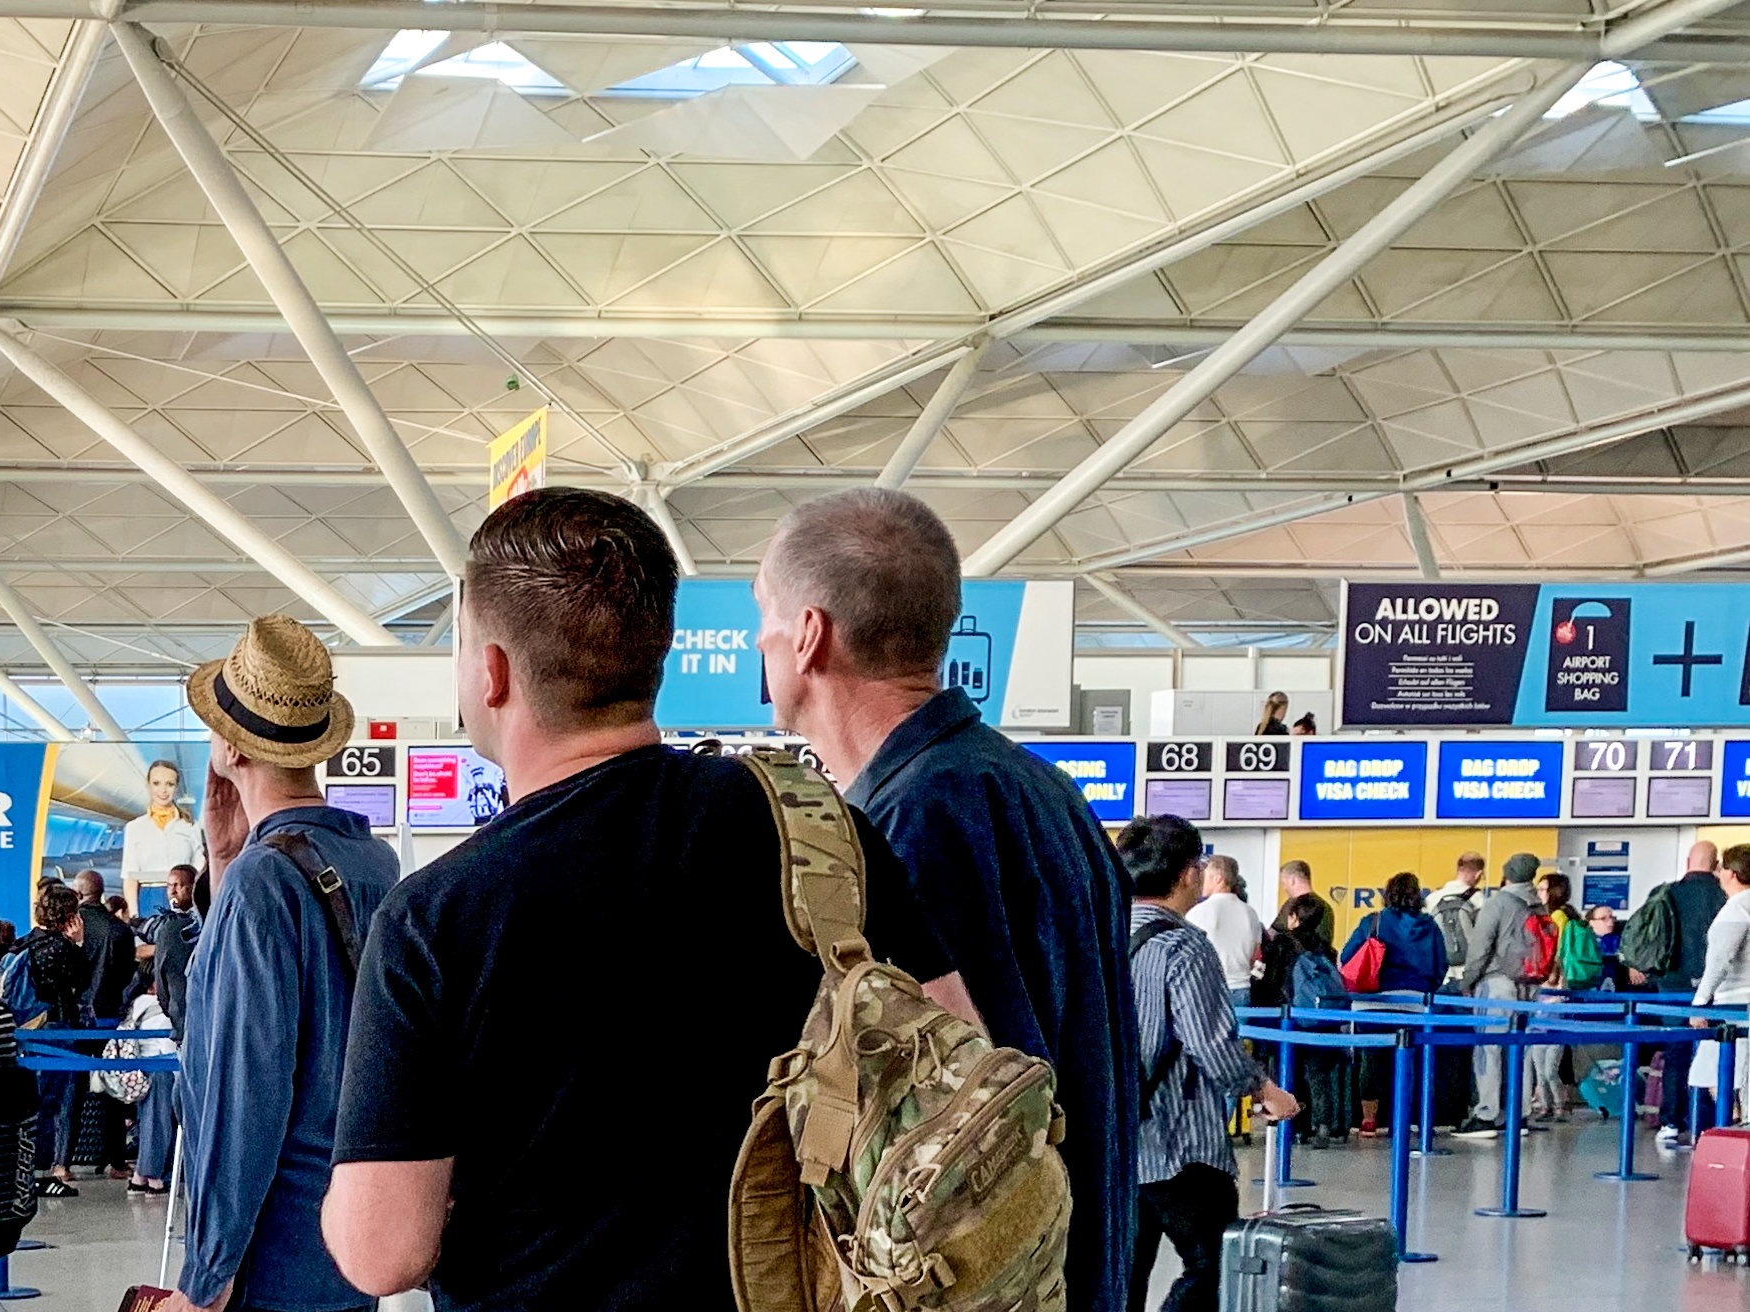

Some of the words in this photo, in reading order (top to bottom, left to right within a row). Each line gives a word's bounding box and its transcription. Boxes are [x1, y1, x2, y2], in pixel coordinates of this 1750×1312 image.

[1375, 598, 1499, 621] ALLOWED
[672, 629, 748, 650] CHECK
[1355, 623, 1392, 643] ON
[1398, 624, 1430, 644] ALL
[1437, 624, 1515, 644] FLIGHTS
[1587, 626, 1593, 650] 1
[681, 654, 702, 674] IT
[709, 654, 736, 674] IN
[1563, 656, 1610, 668] AIRPORT
[1557, 672, 1619, 684] SHOPPING
[1575, 688, 1600, 700] BAG
[341, 748, 382, 776] 65
[1161, 743, 1198, 771] 68
[1239, 743, 1277, 771] 69
[1588, 742, 1625, 771] 70
[1664, 741, 1697, 770] 71
[1324, 760, 1357, 778] BAG
[1359, 759, 1403, 778] DROP
[1461, 759, 1493, 777] BAG
[1496, 759, 1540, 777] DROP
[1316, 783, 1353, 800] VISA
[1355, 782, 1410, 800] CHECK
[1453, 782, 1490, 799] VISA
[1492, 781, 1546, 799] CHECK
